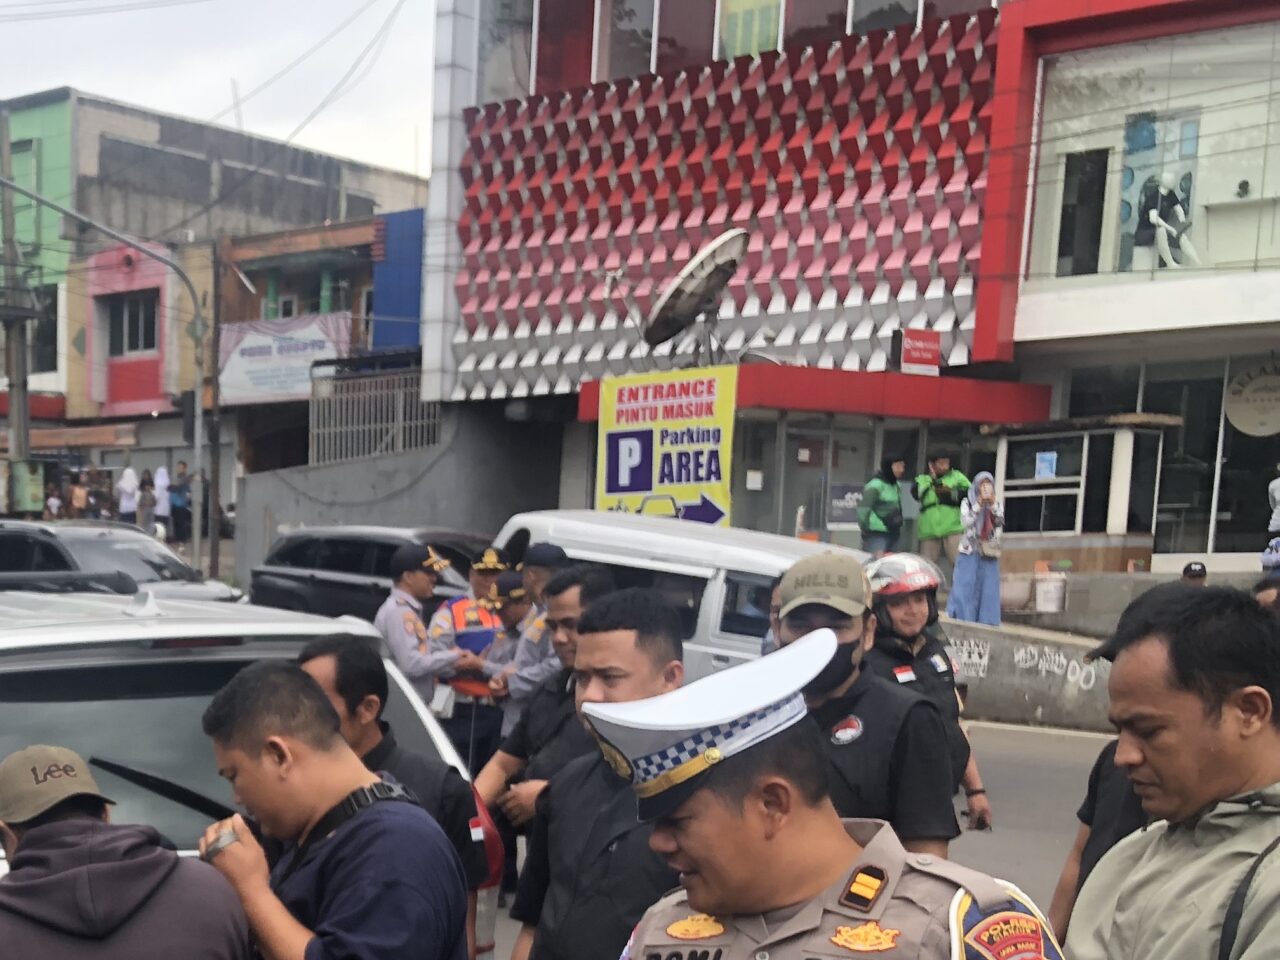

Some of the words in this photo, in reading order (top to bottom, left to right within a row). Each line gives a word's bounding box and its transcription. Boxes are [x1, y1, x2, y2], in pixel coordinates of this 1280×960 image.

[616, 379, 716, 404] ENTRANCE
[616, 406, 659, 425] PINTU
[662, 401, 715, 421] MASUK
[660, 427, 721, 446] Parking
[617, 437, 641, 488] P
[659, 450, 721, 484] AREA
[30, 763, 77, 785] Lee
